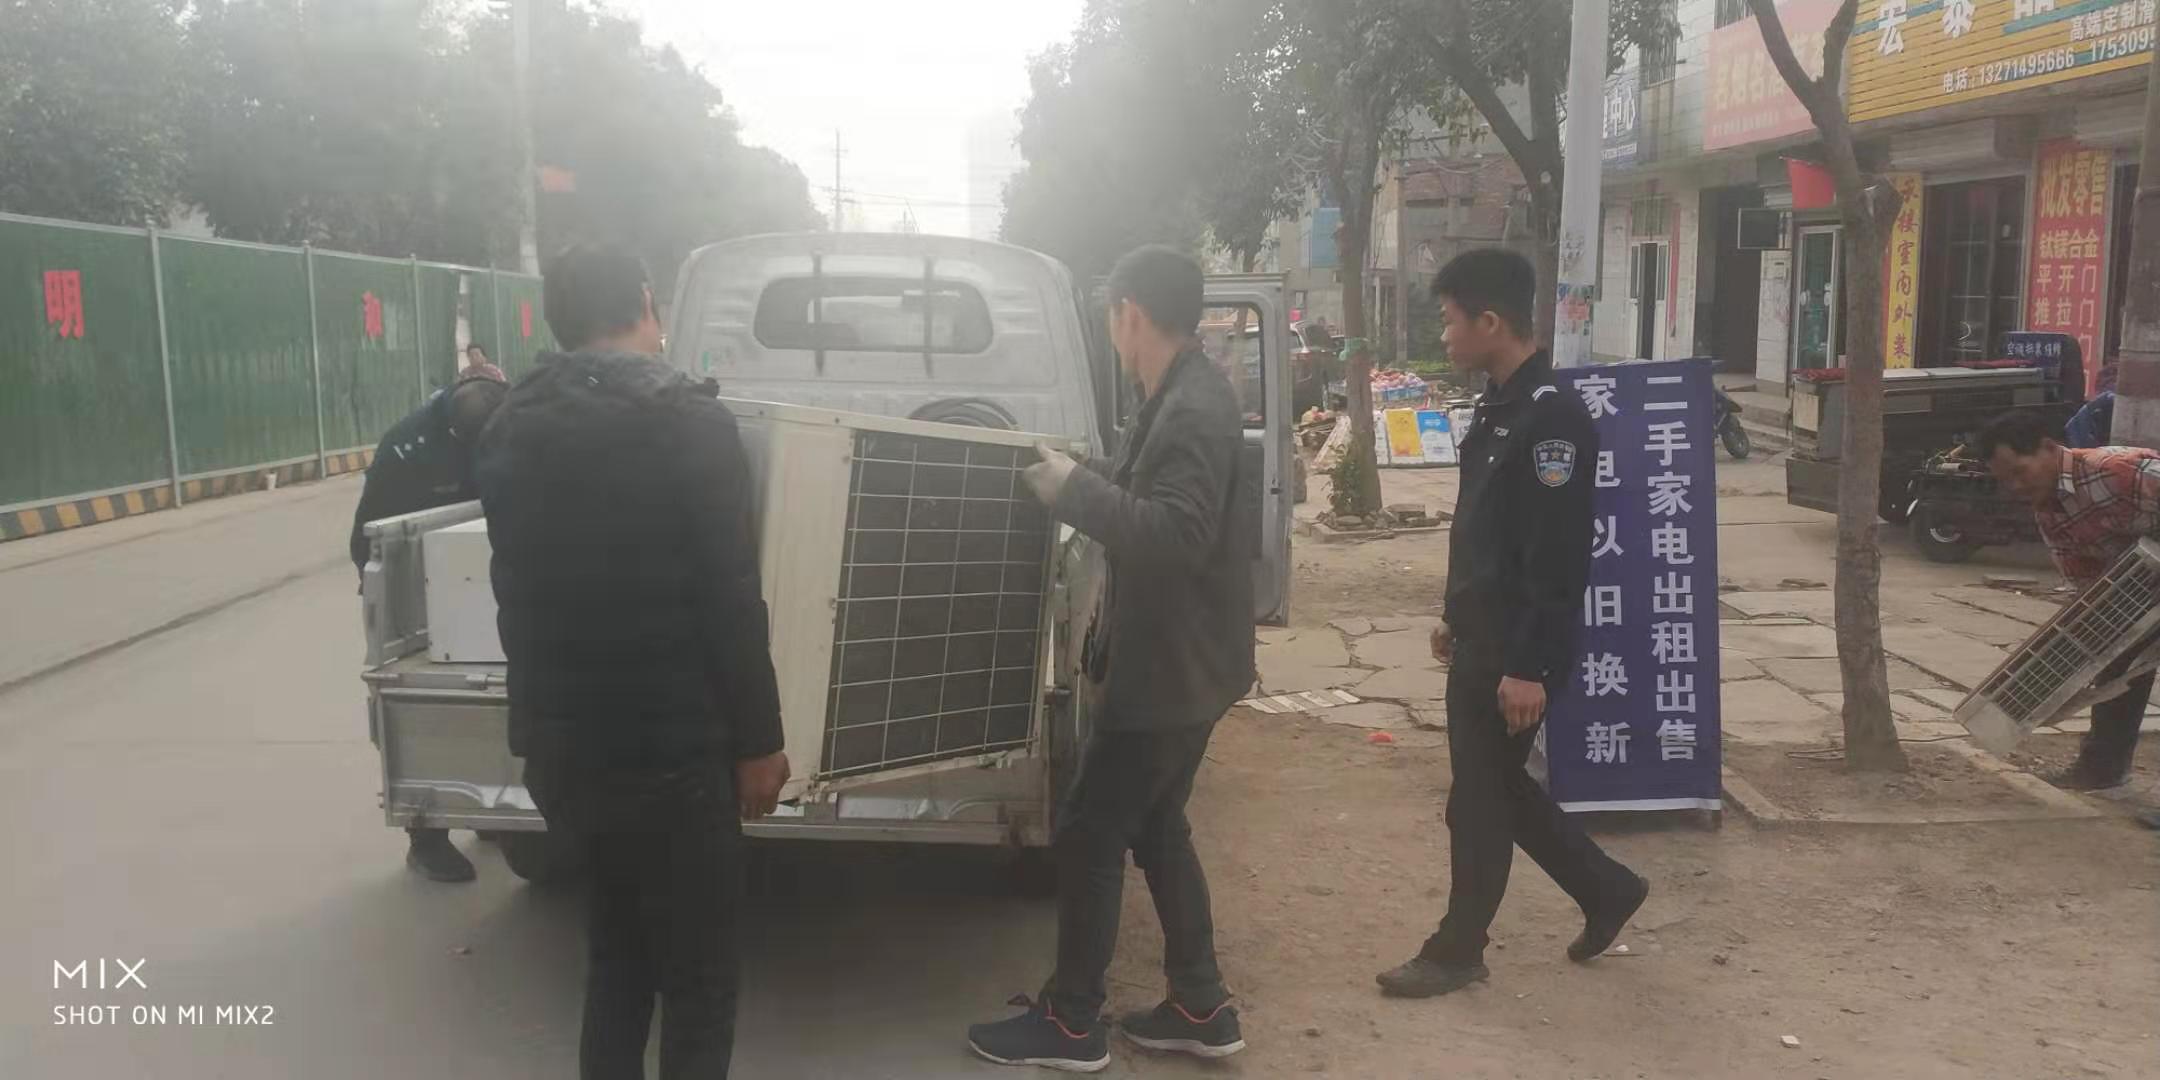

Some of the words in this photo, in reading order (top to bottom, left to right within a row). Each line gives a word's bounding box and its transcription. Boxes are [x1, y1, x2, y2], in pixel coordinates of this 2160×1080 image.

[2041, 151, 2107, 218] 批发零售
[1893, 175, 1919, 368] 承接室内外装
[2039, 229, 2099, 259] 钛镁合金
[44, 270, 85, 339] 明
[2036, 264, 2097, 293] 平开门
[2034, 299, 2095, 328] 推拉门
[1643, 375, 1698, 761] 二手家电出租出售
